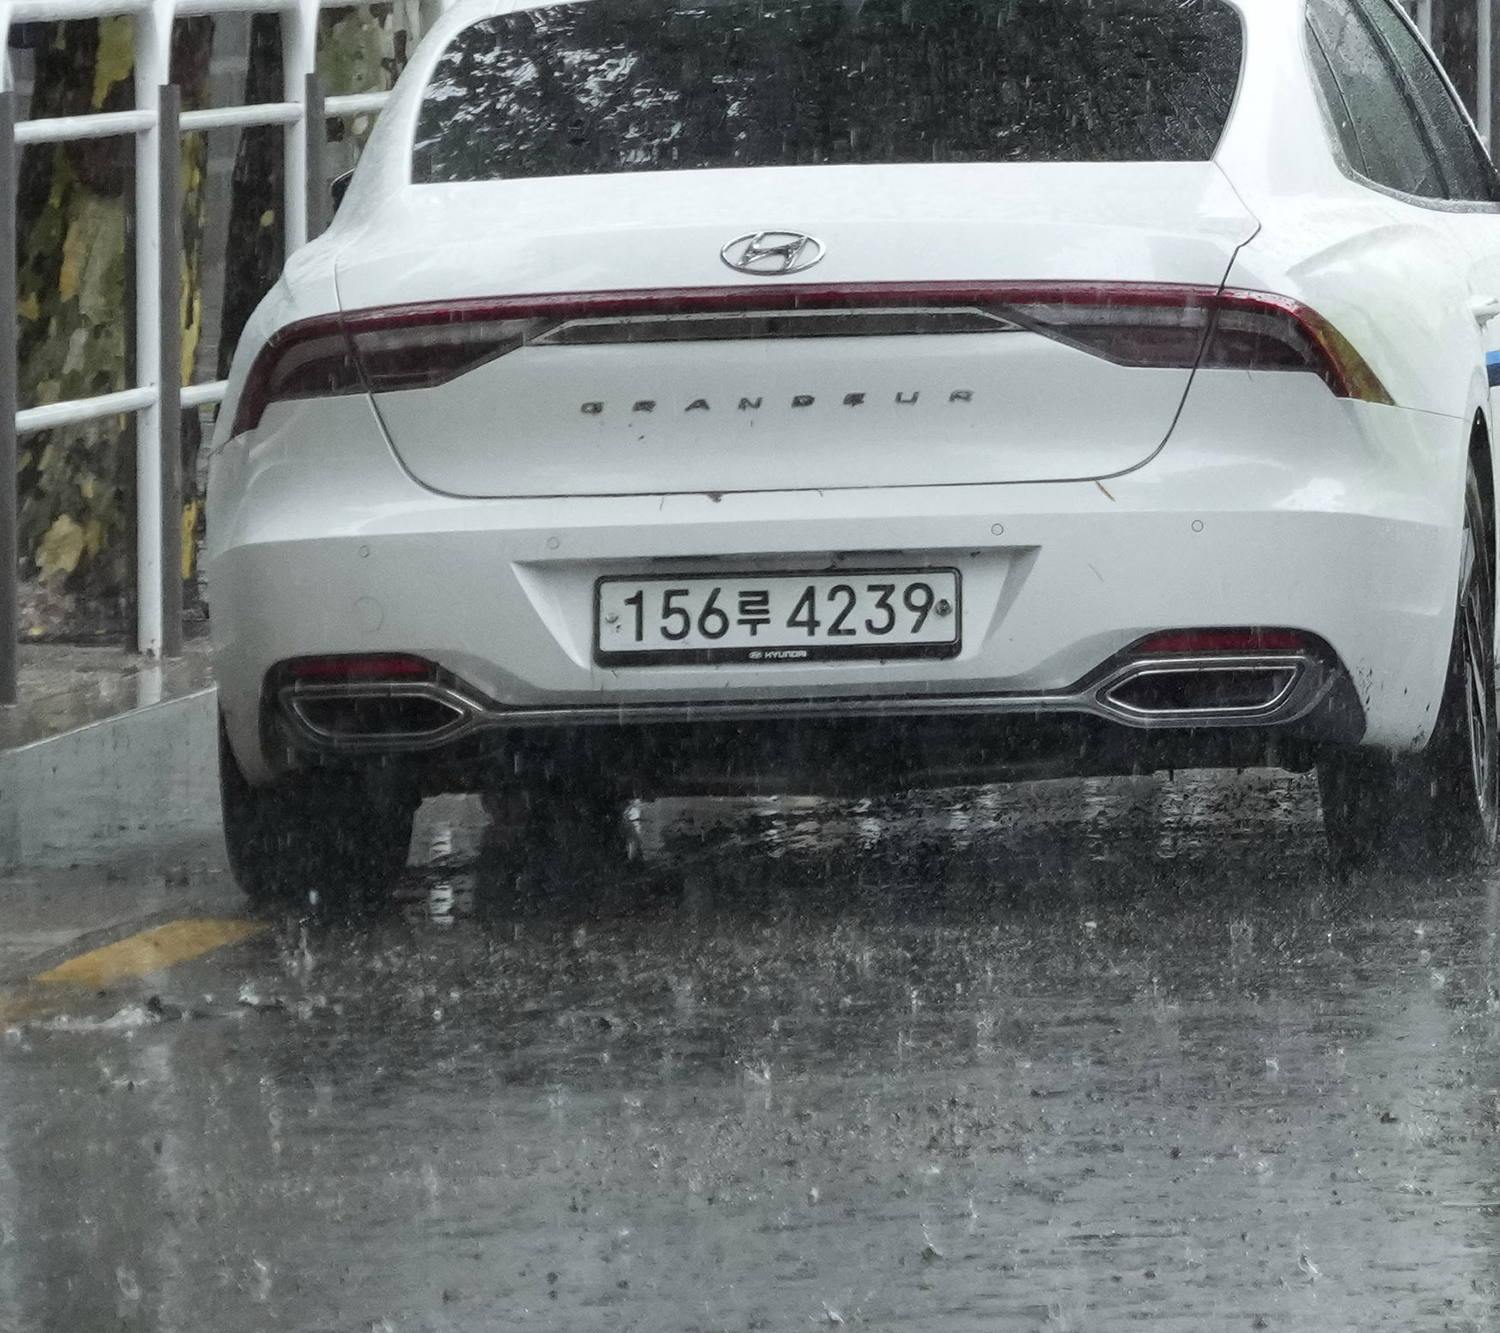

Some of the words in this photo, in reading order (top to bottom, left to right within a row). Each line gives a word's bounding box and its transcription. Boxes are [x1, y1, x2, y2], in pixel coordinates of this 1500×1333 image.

[580, 389, 975, 416] GRANDEUR
[623, 586, 772, 642] 156루
[785, 581, 936, 637] 4239
[764, 650, 807, 659] HYUNDAI
